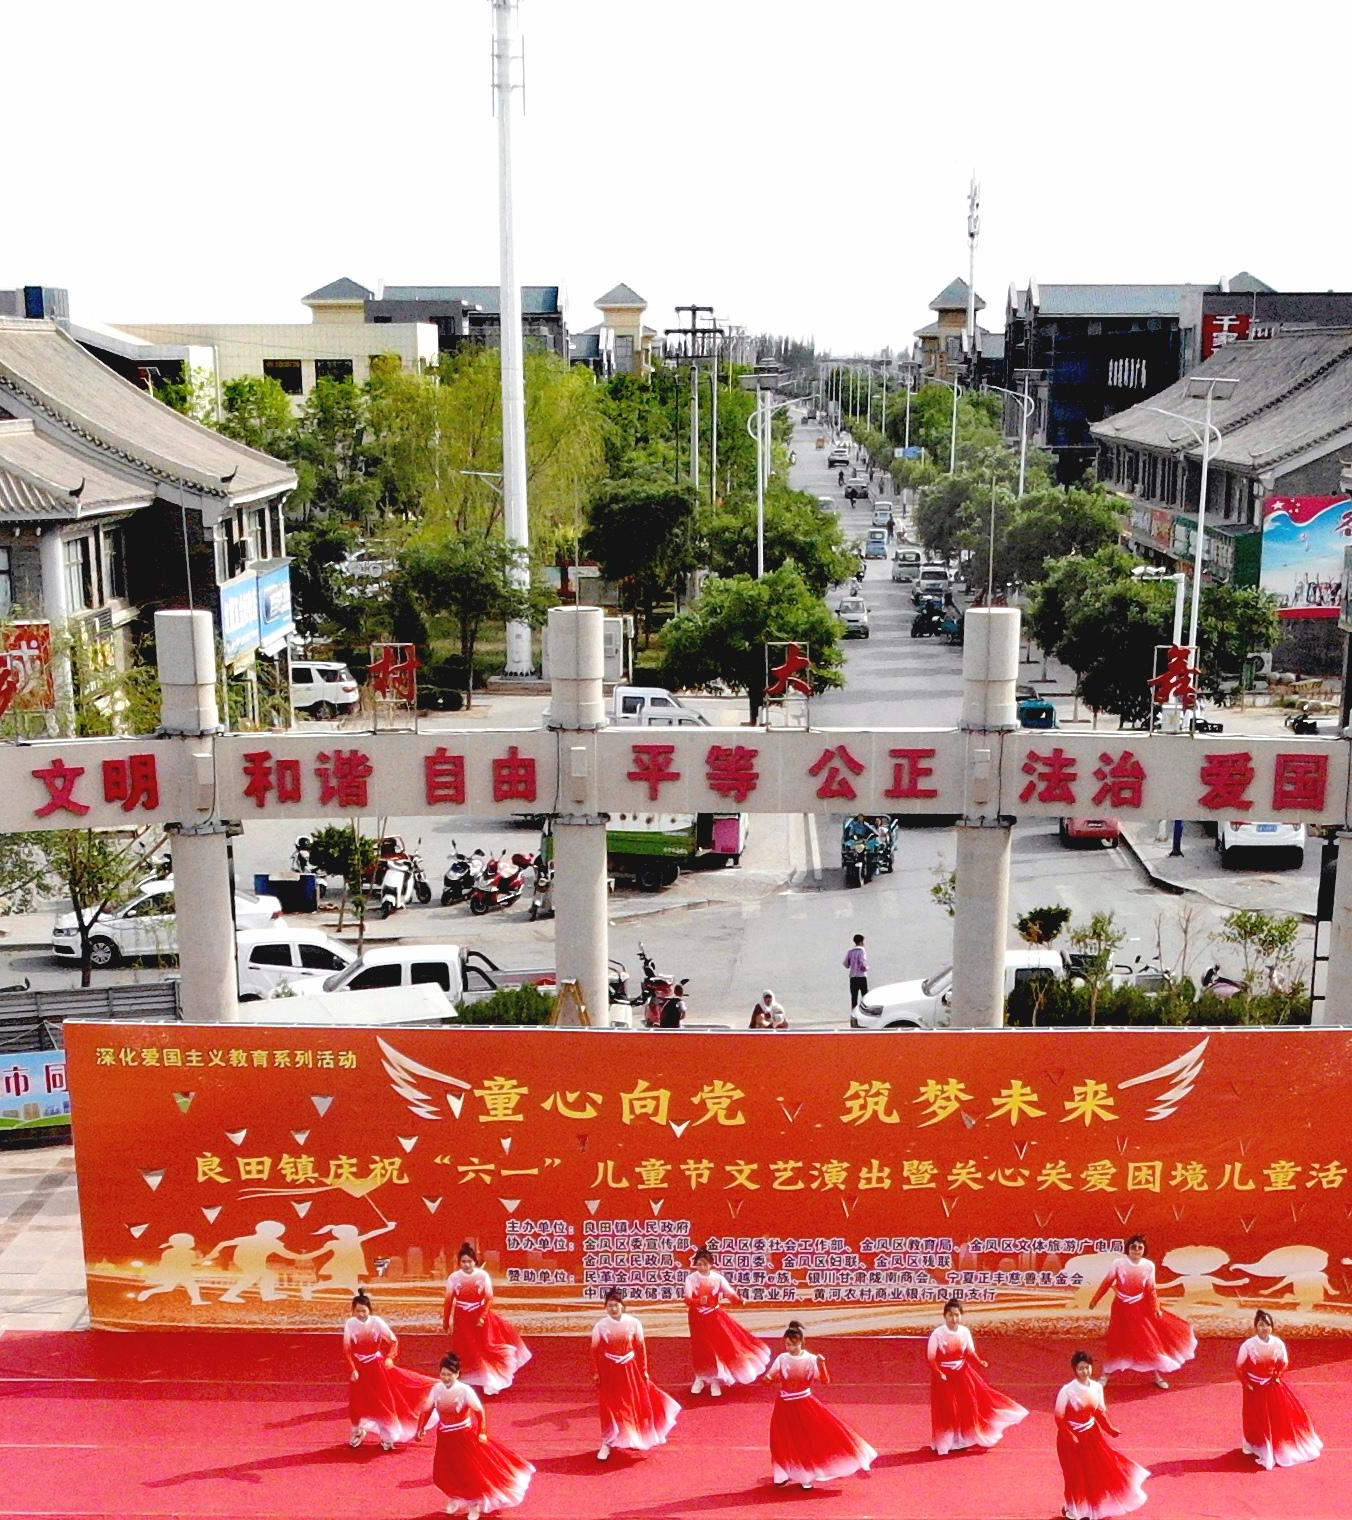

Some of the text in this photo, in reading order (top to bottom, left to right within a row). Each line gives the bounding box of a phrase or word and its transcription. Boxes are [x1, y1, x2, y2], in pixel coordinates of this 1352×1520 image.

[368, 644, 422, 702] 村
[767, 643, 813, 697] 大
[32, 754, 159, 817] 文明
[243, 750, 372, 807] 和谐
[425, 747, 536, 804] 自由
[627, 745, 759, 802] 平等
[810, 745, 937, 799] 公正
[1020, 749, 1146, 808] 法治
[1199, 752, 1328, 811] 爱国
[95, 1046, 357, 1069] 深化爱国主义教育系列活动
[473, 1075, 1119, 1128] 童心向党 筑梦未来
